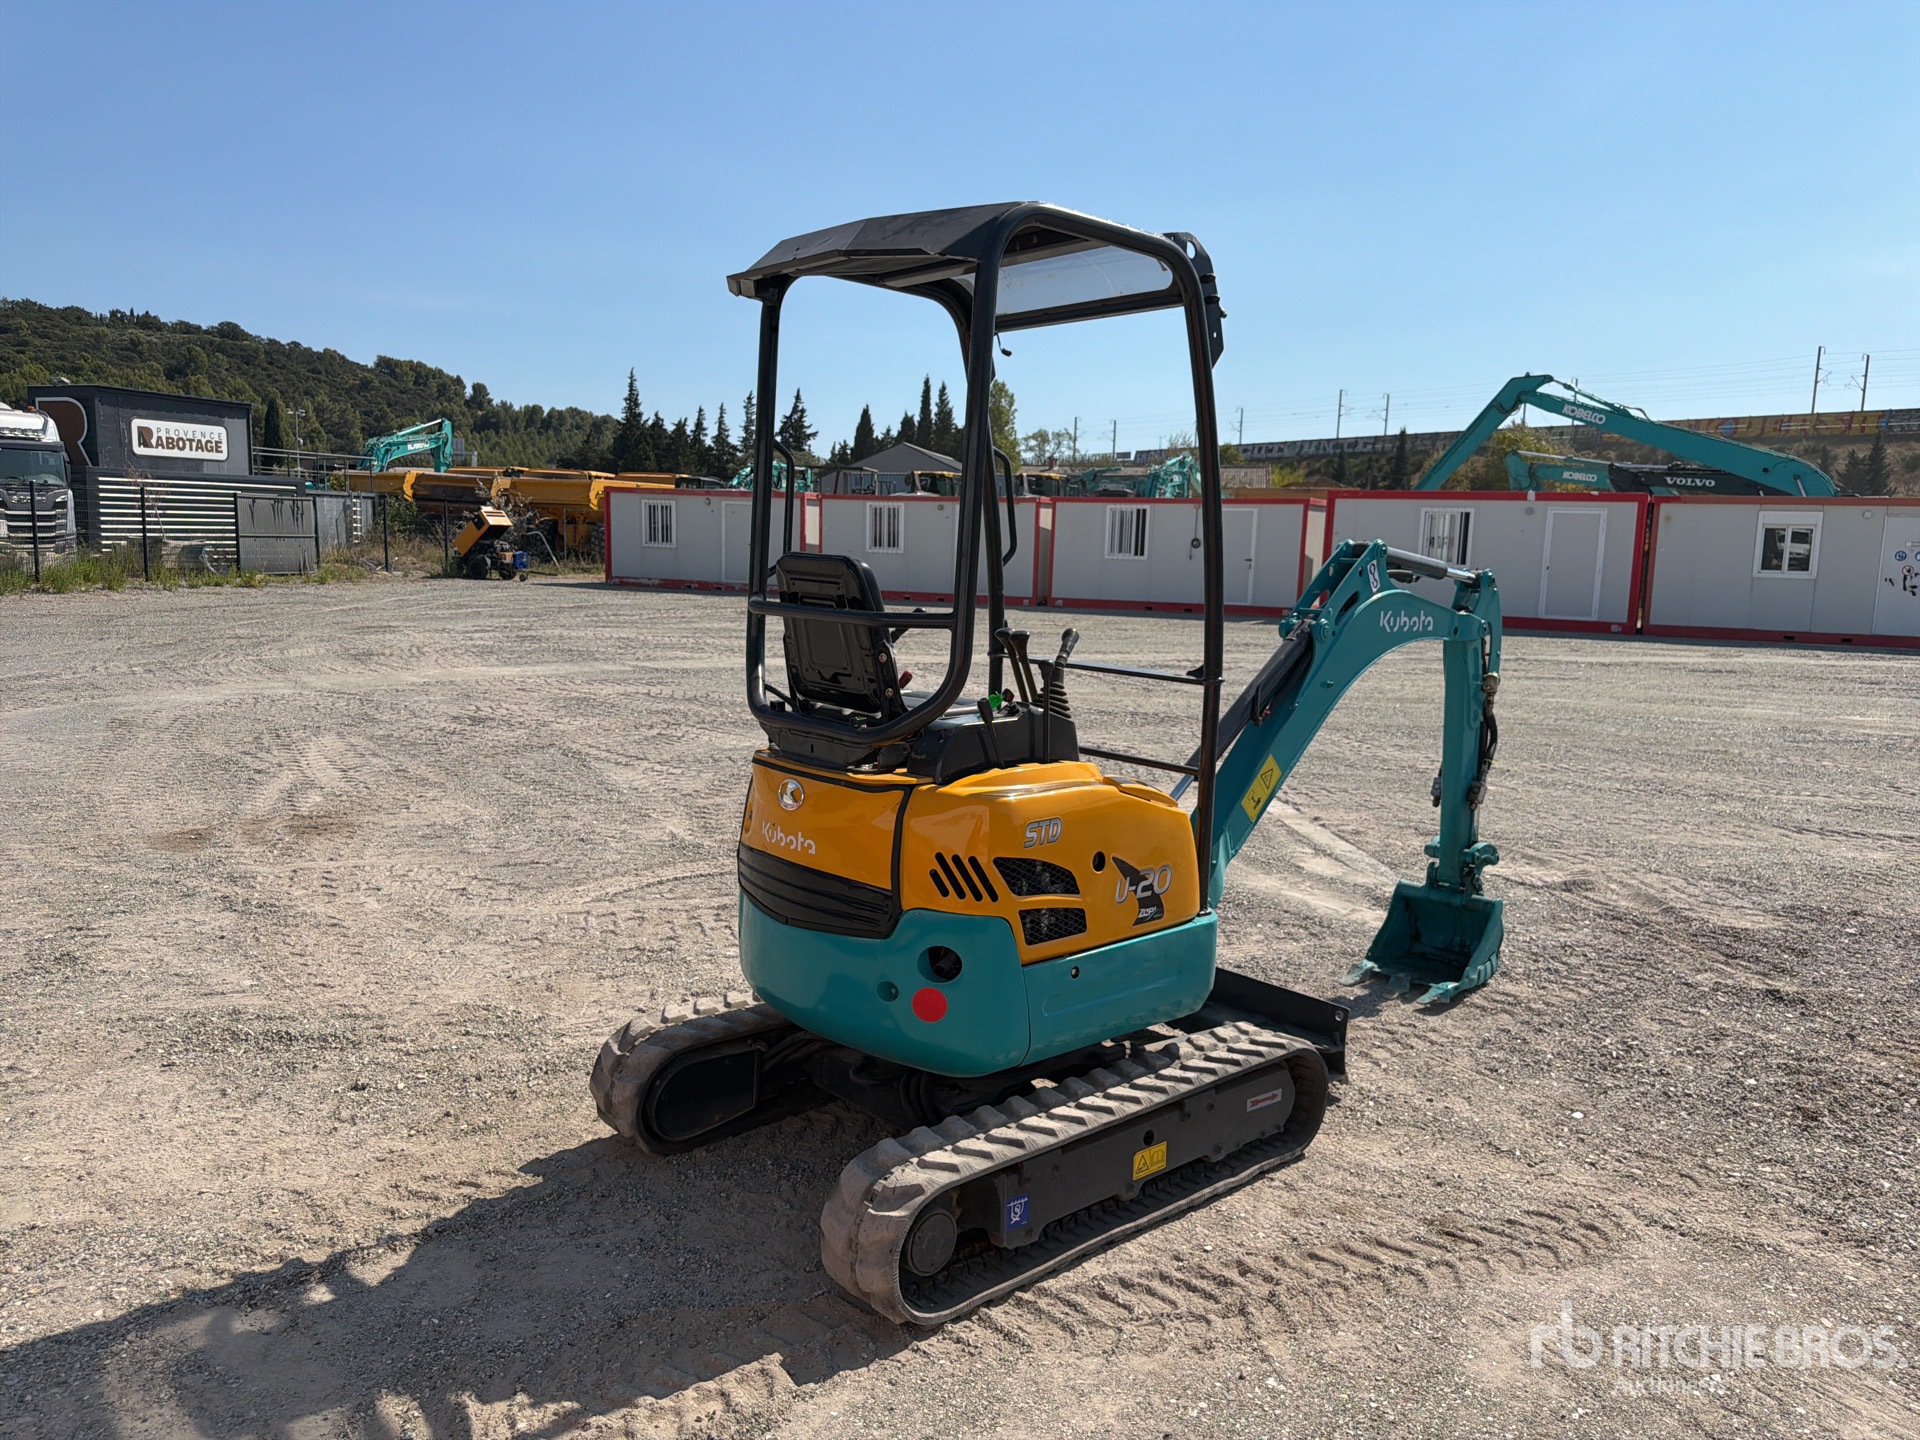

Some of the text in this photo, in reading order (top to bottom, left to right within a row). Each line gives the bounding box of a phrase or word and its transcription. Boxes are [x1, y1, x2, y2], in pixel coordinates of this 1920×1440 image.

[1562, 403, 1607, 425] KOBELCO
[137, 425, 224, 454] RABOTAGE
[156, 426, 223, 441] PROVENCE
[1562, 471, 1598, 482] KOBELCO
[1663, 476, 1716, 488] VOLVO
[1379, 610, 1434, 633] Kubota
[761, 820, 816, 855] Kubota
[1023, 816, 1063, 848] STD
[1115, 864, 1173, 904] U-20
